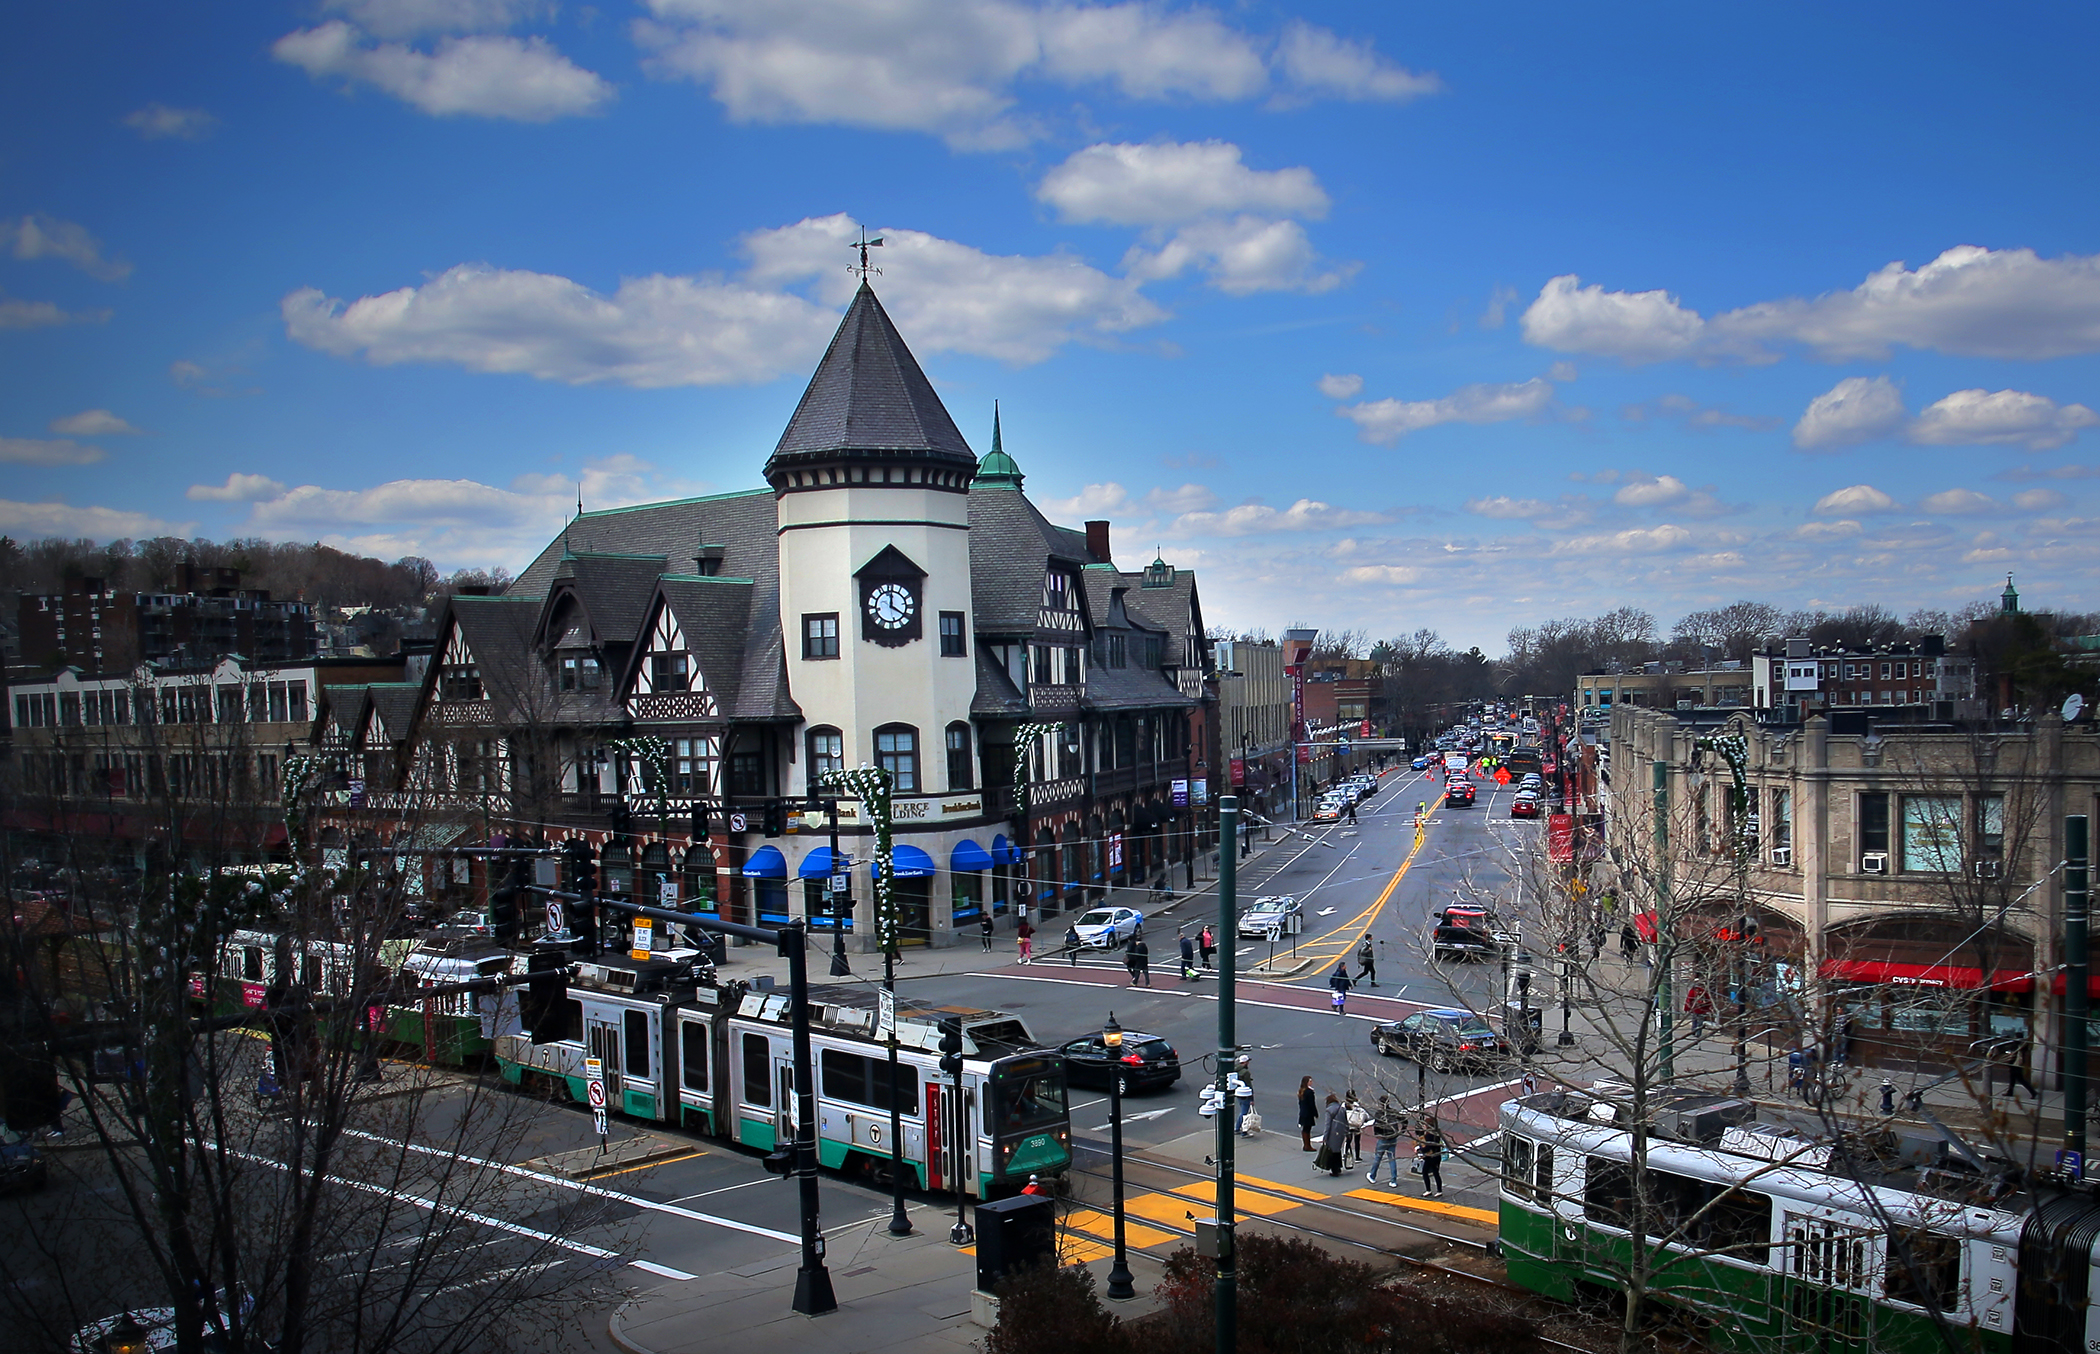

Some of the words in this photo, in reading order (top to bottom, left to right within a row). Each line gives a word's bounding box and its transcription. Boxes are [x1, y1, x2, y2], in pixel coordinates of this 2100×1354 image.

[893, 802, 930, 812] PIERCE
[892, 810, 926, 819] LDING
[1030, 1137, 1046, 1149] 3890
